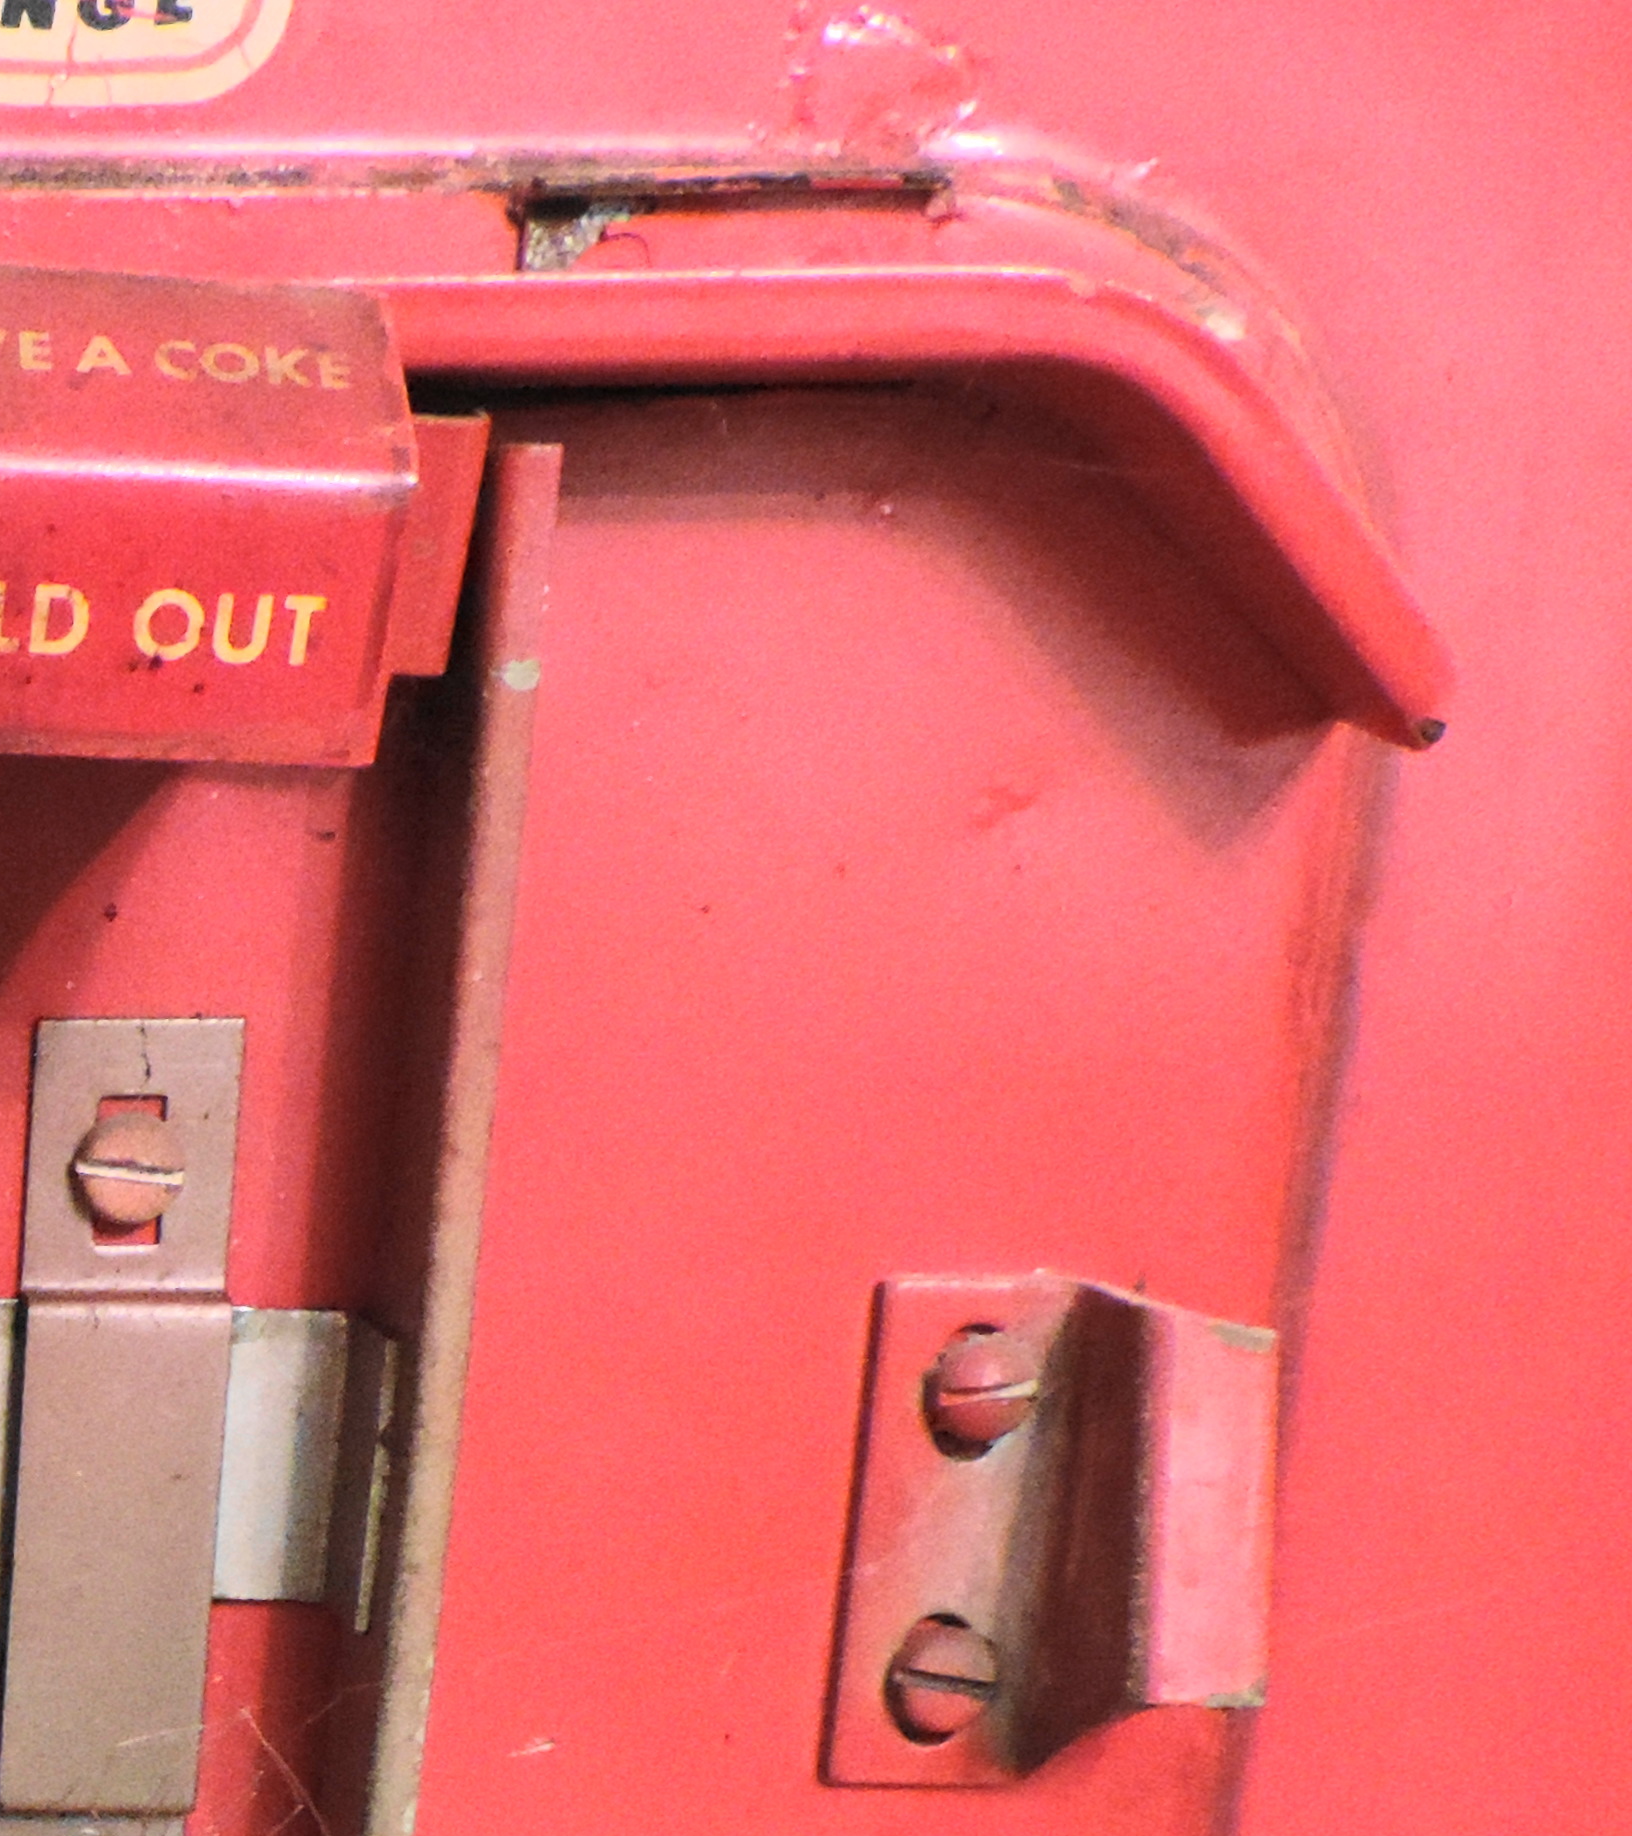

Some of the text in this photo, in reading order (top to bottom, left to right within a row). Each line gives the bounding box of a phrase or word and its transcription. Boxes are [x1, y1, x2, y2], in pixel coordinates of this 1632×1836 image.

[75, 334, 130, 378] A
[154, 340, 353, 391] COKE
[132, 588, 328, 667] OUT
